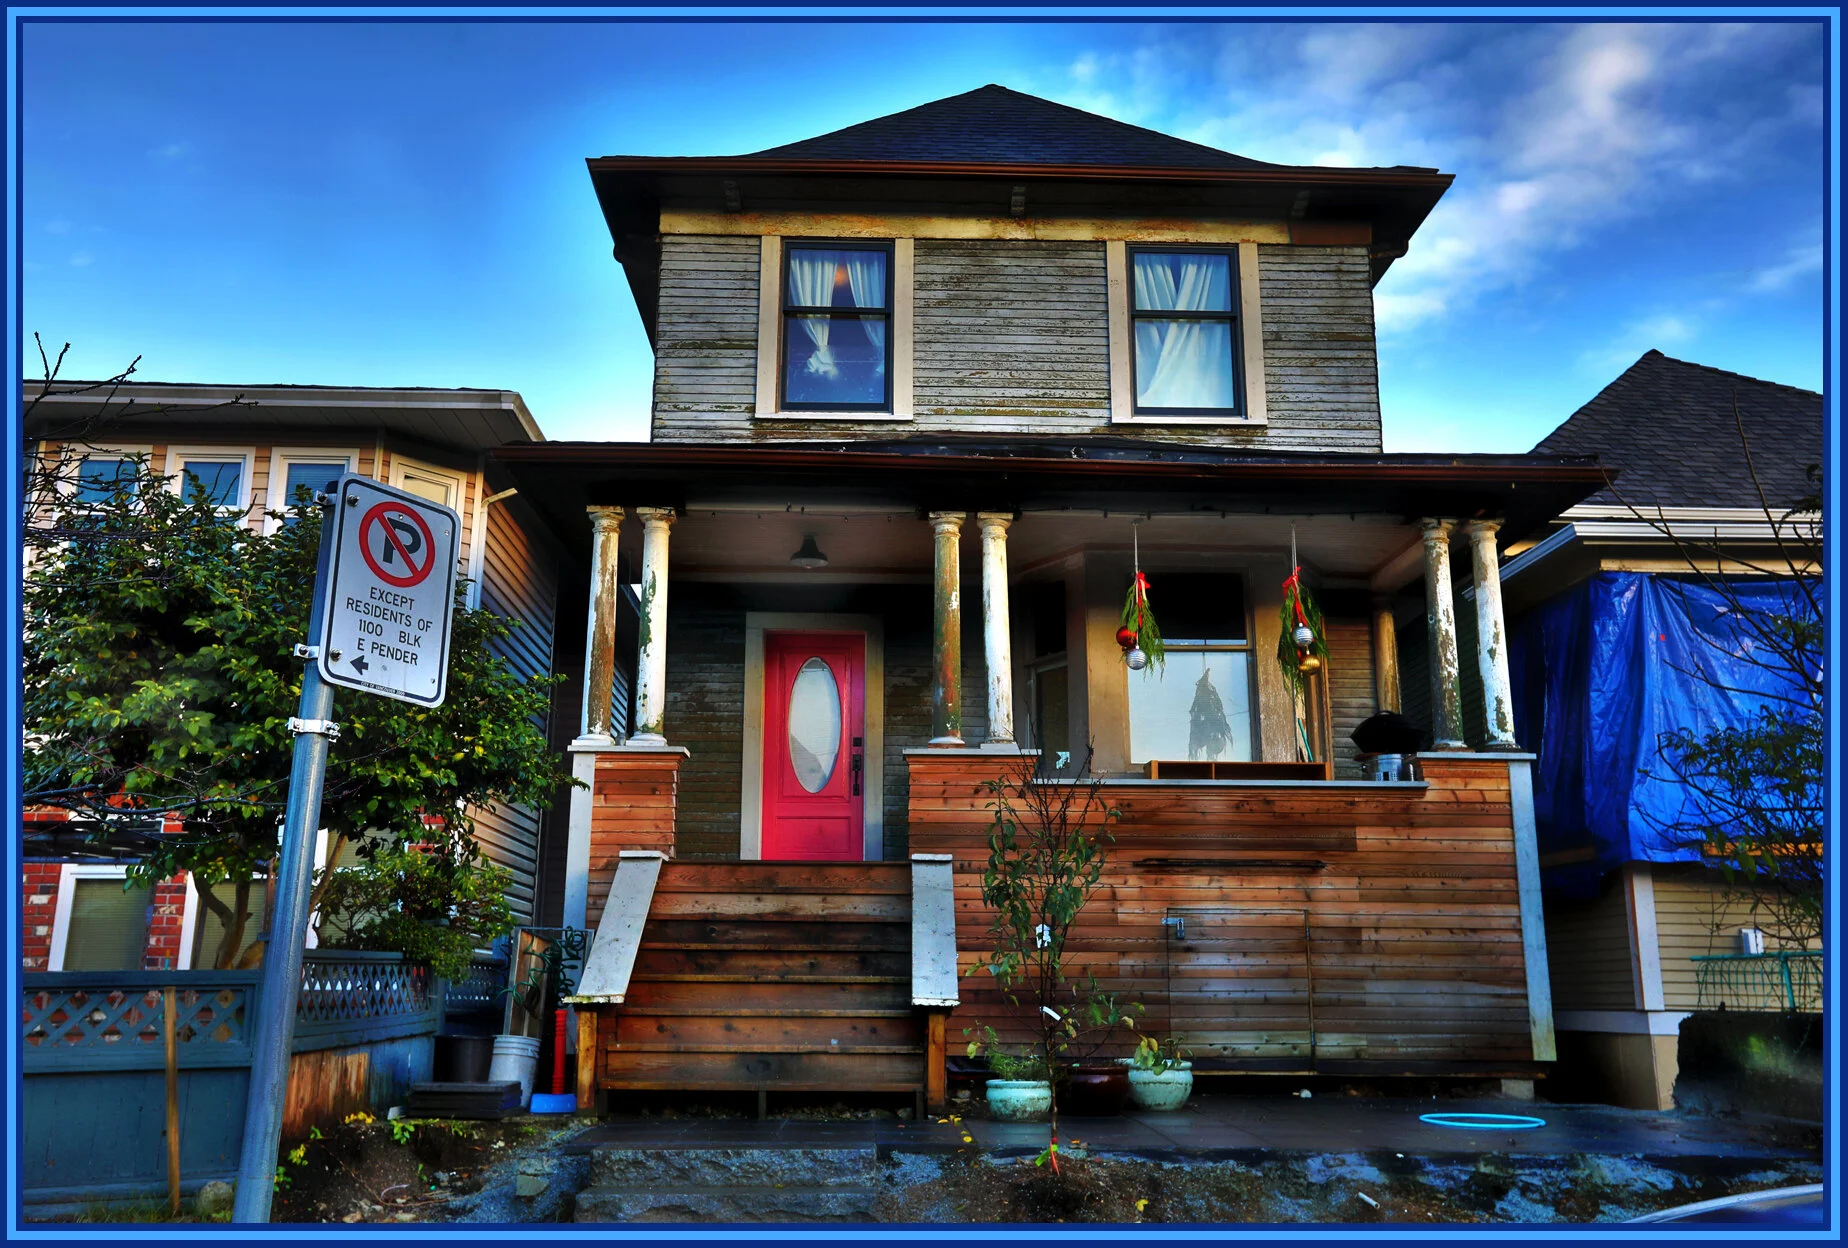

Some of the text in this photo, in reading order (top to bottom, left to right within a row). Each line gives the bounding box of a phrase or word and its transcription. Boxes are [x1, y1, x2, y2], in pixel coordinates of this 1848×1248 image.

[370, 587, 414, 610] EXCEPT
[347, 598, 432, 632] RESIDENTS OF
[359, 619, 421, 648] 1100 BLK
[357, 638, 417, 665] E PENDER
